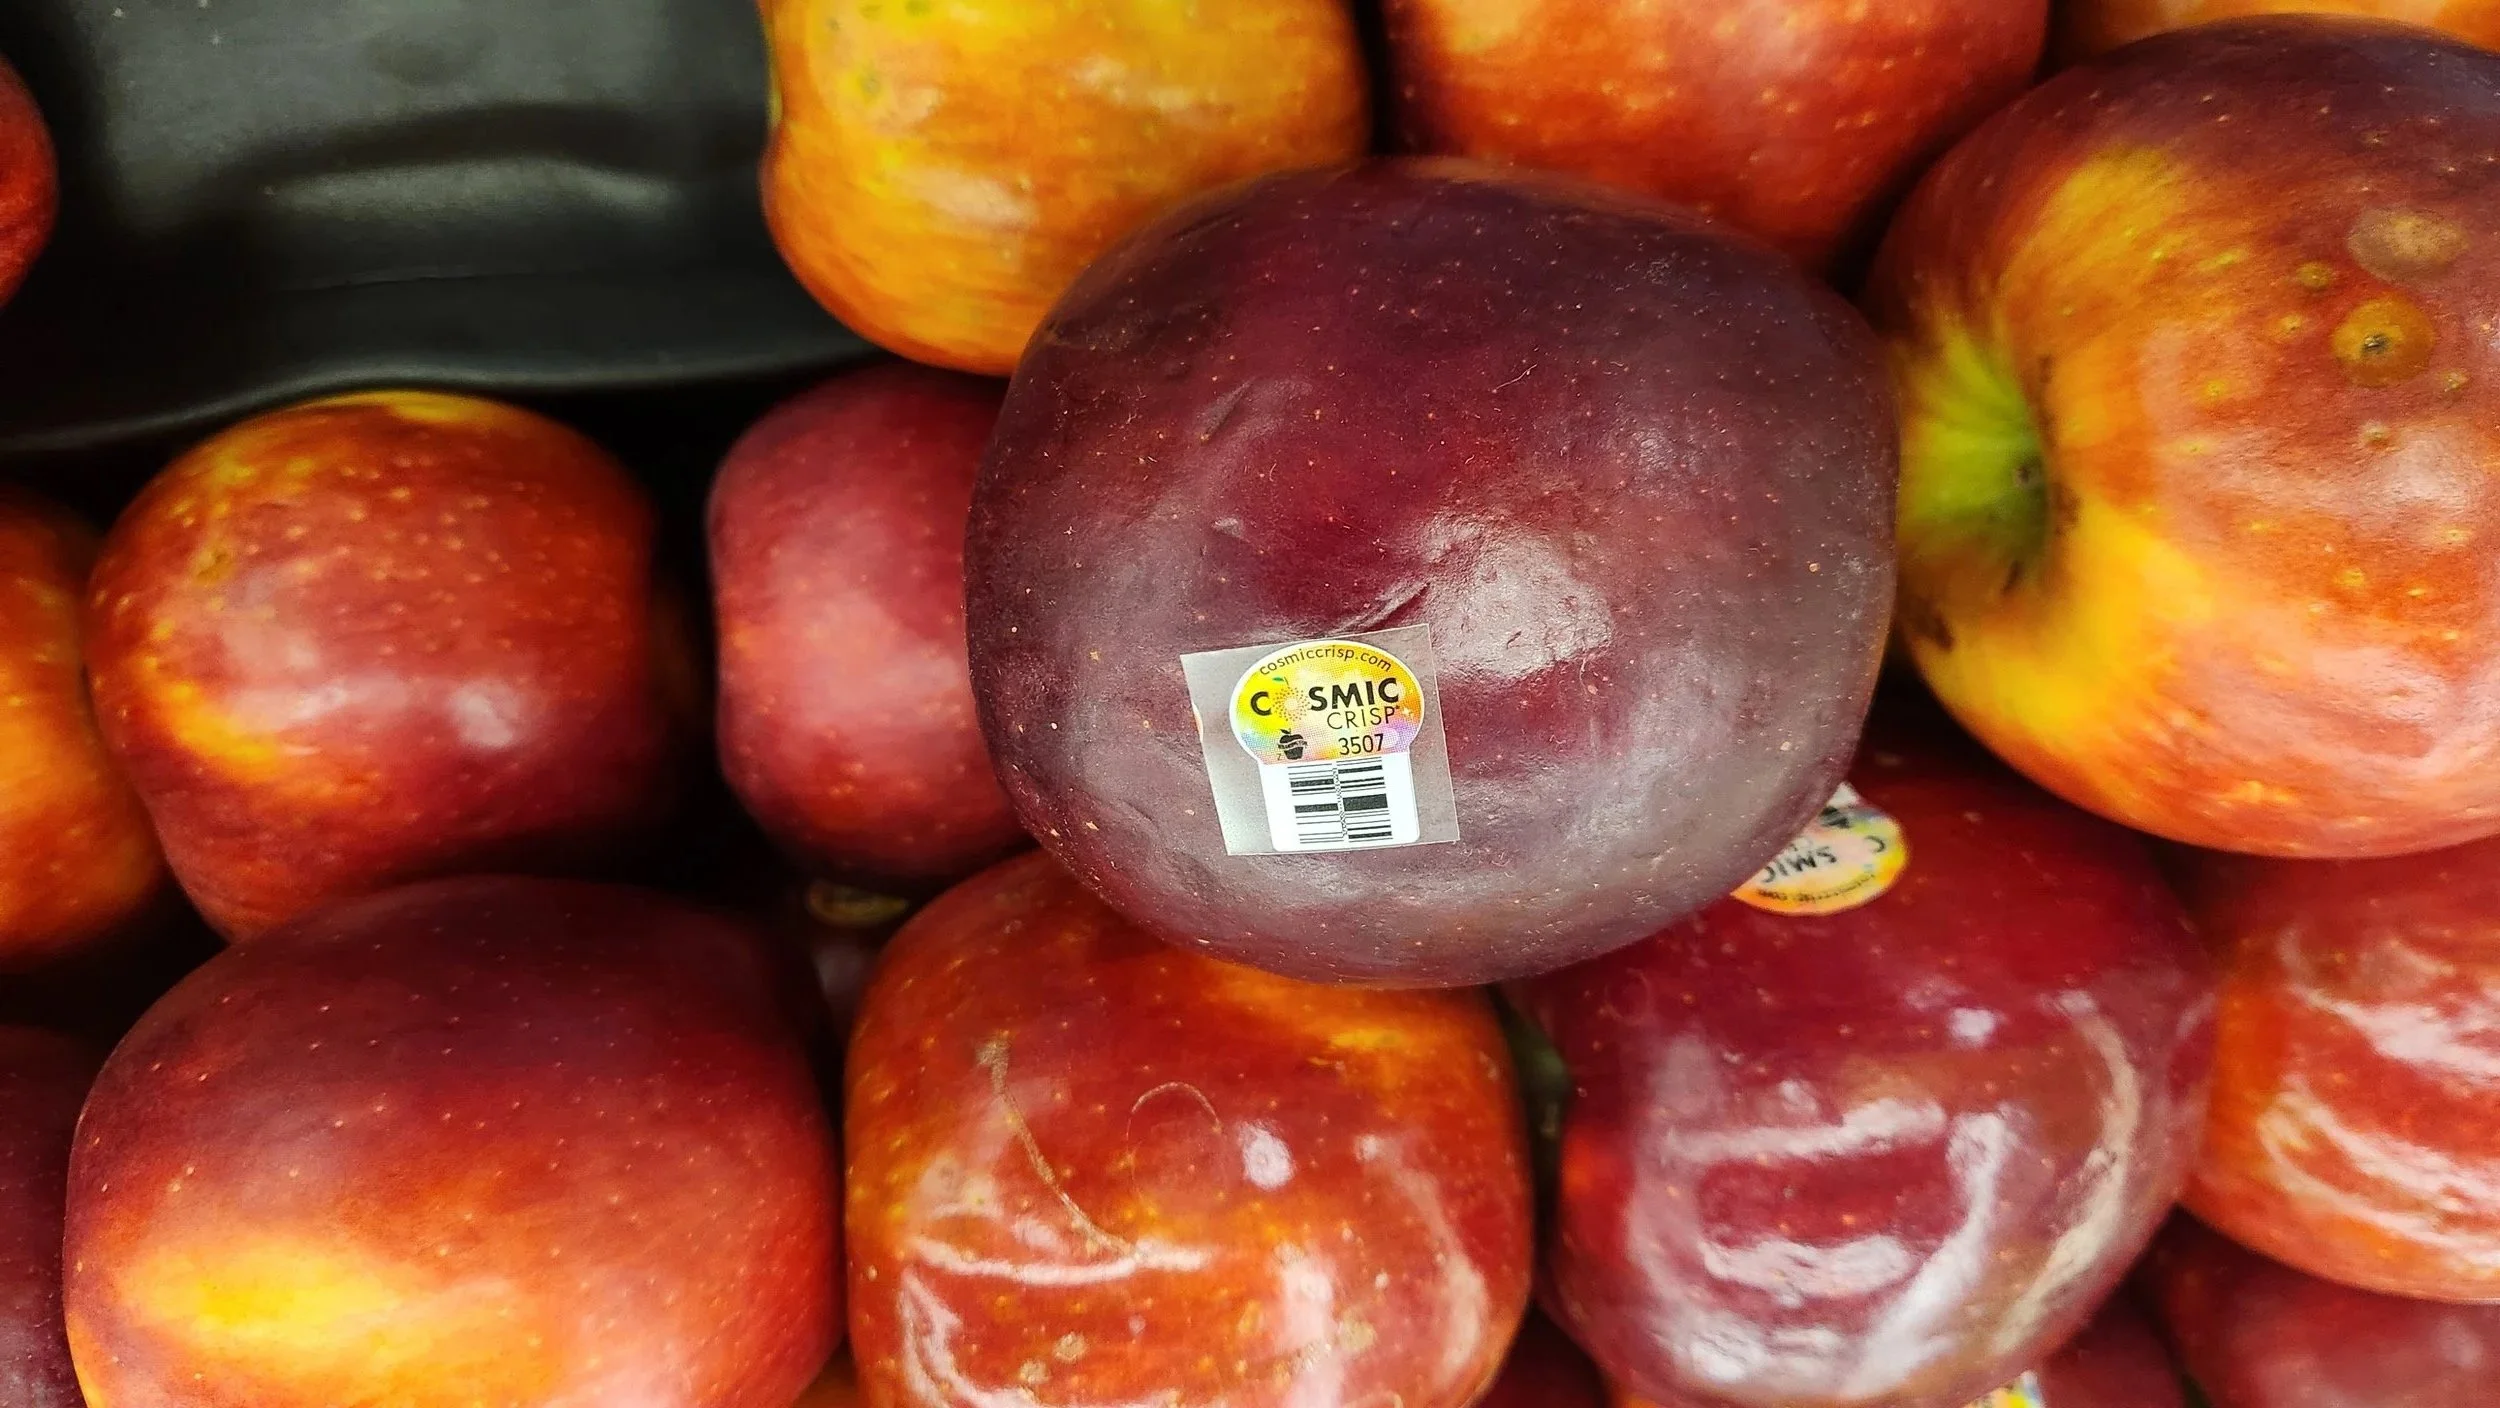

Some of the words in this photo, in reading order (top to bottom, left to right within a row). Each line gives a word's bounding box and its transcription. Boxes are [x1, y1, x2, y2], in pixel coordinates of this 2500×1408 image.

[1259, 645, 1392, 676] cosmiccrisp.com
[1326, 706, 1396, 730] CRISP
[1338, 733, 1384, 756] 3507
